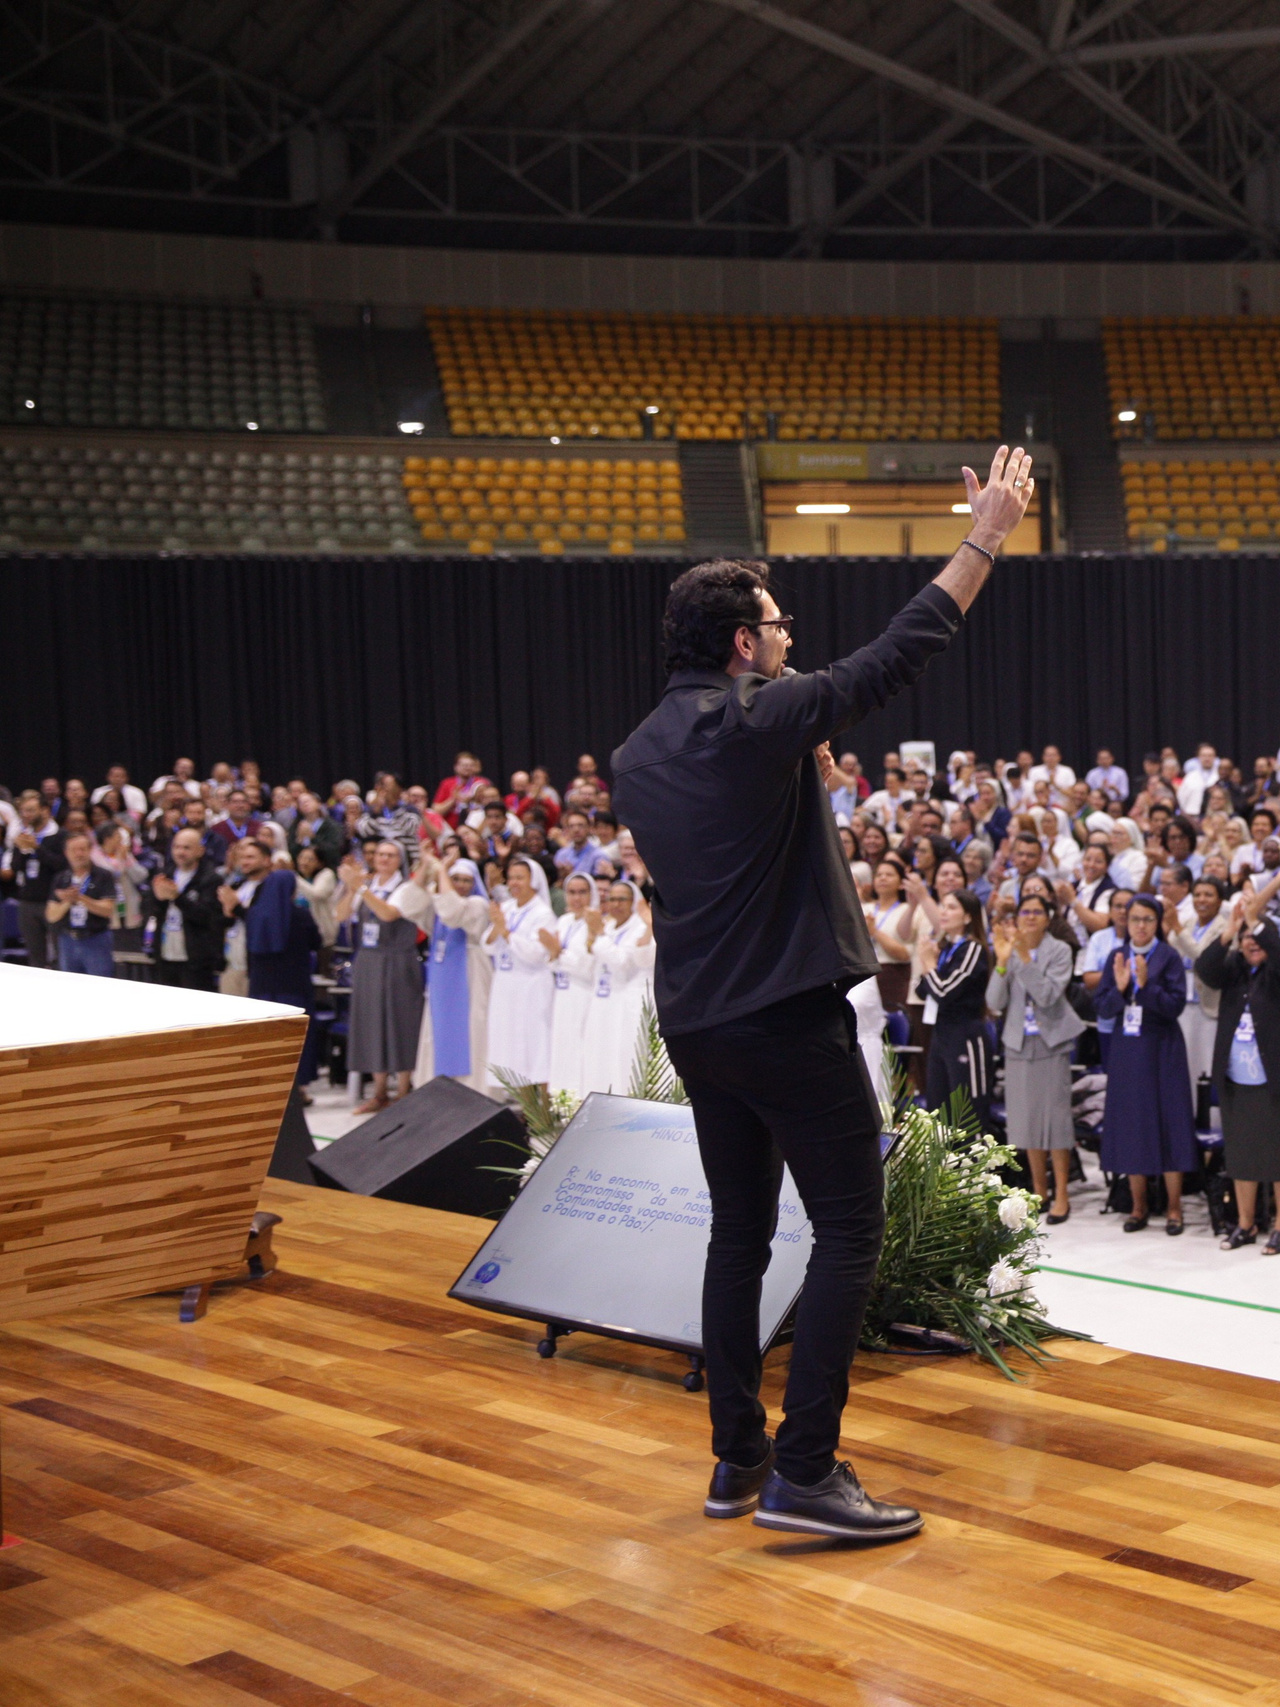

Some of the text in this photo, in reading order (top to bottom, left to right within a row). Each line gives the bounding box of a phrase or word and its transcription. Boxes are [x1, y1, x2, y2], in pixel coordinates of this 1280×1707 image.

[650, 1127, 683, 1142] HINO
[559, 1177, 634, 1201] Compromisso
[650, 1192, 668, 1206] da
[586, 1169, 602, 1182] No
[608, 1176, 661, 1194] encontro,
[670, 1186, 689, 1197] em
[542, 1204, 552, 1213] a
[552, 1202, 596, 1221] Palavra
[597, 1213, 606, 1222] e
[608, 1215, 617, 1224] o
